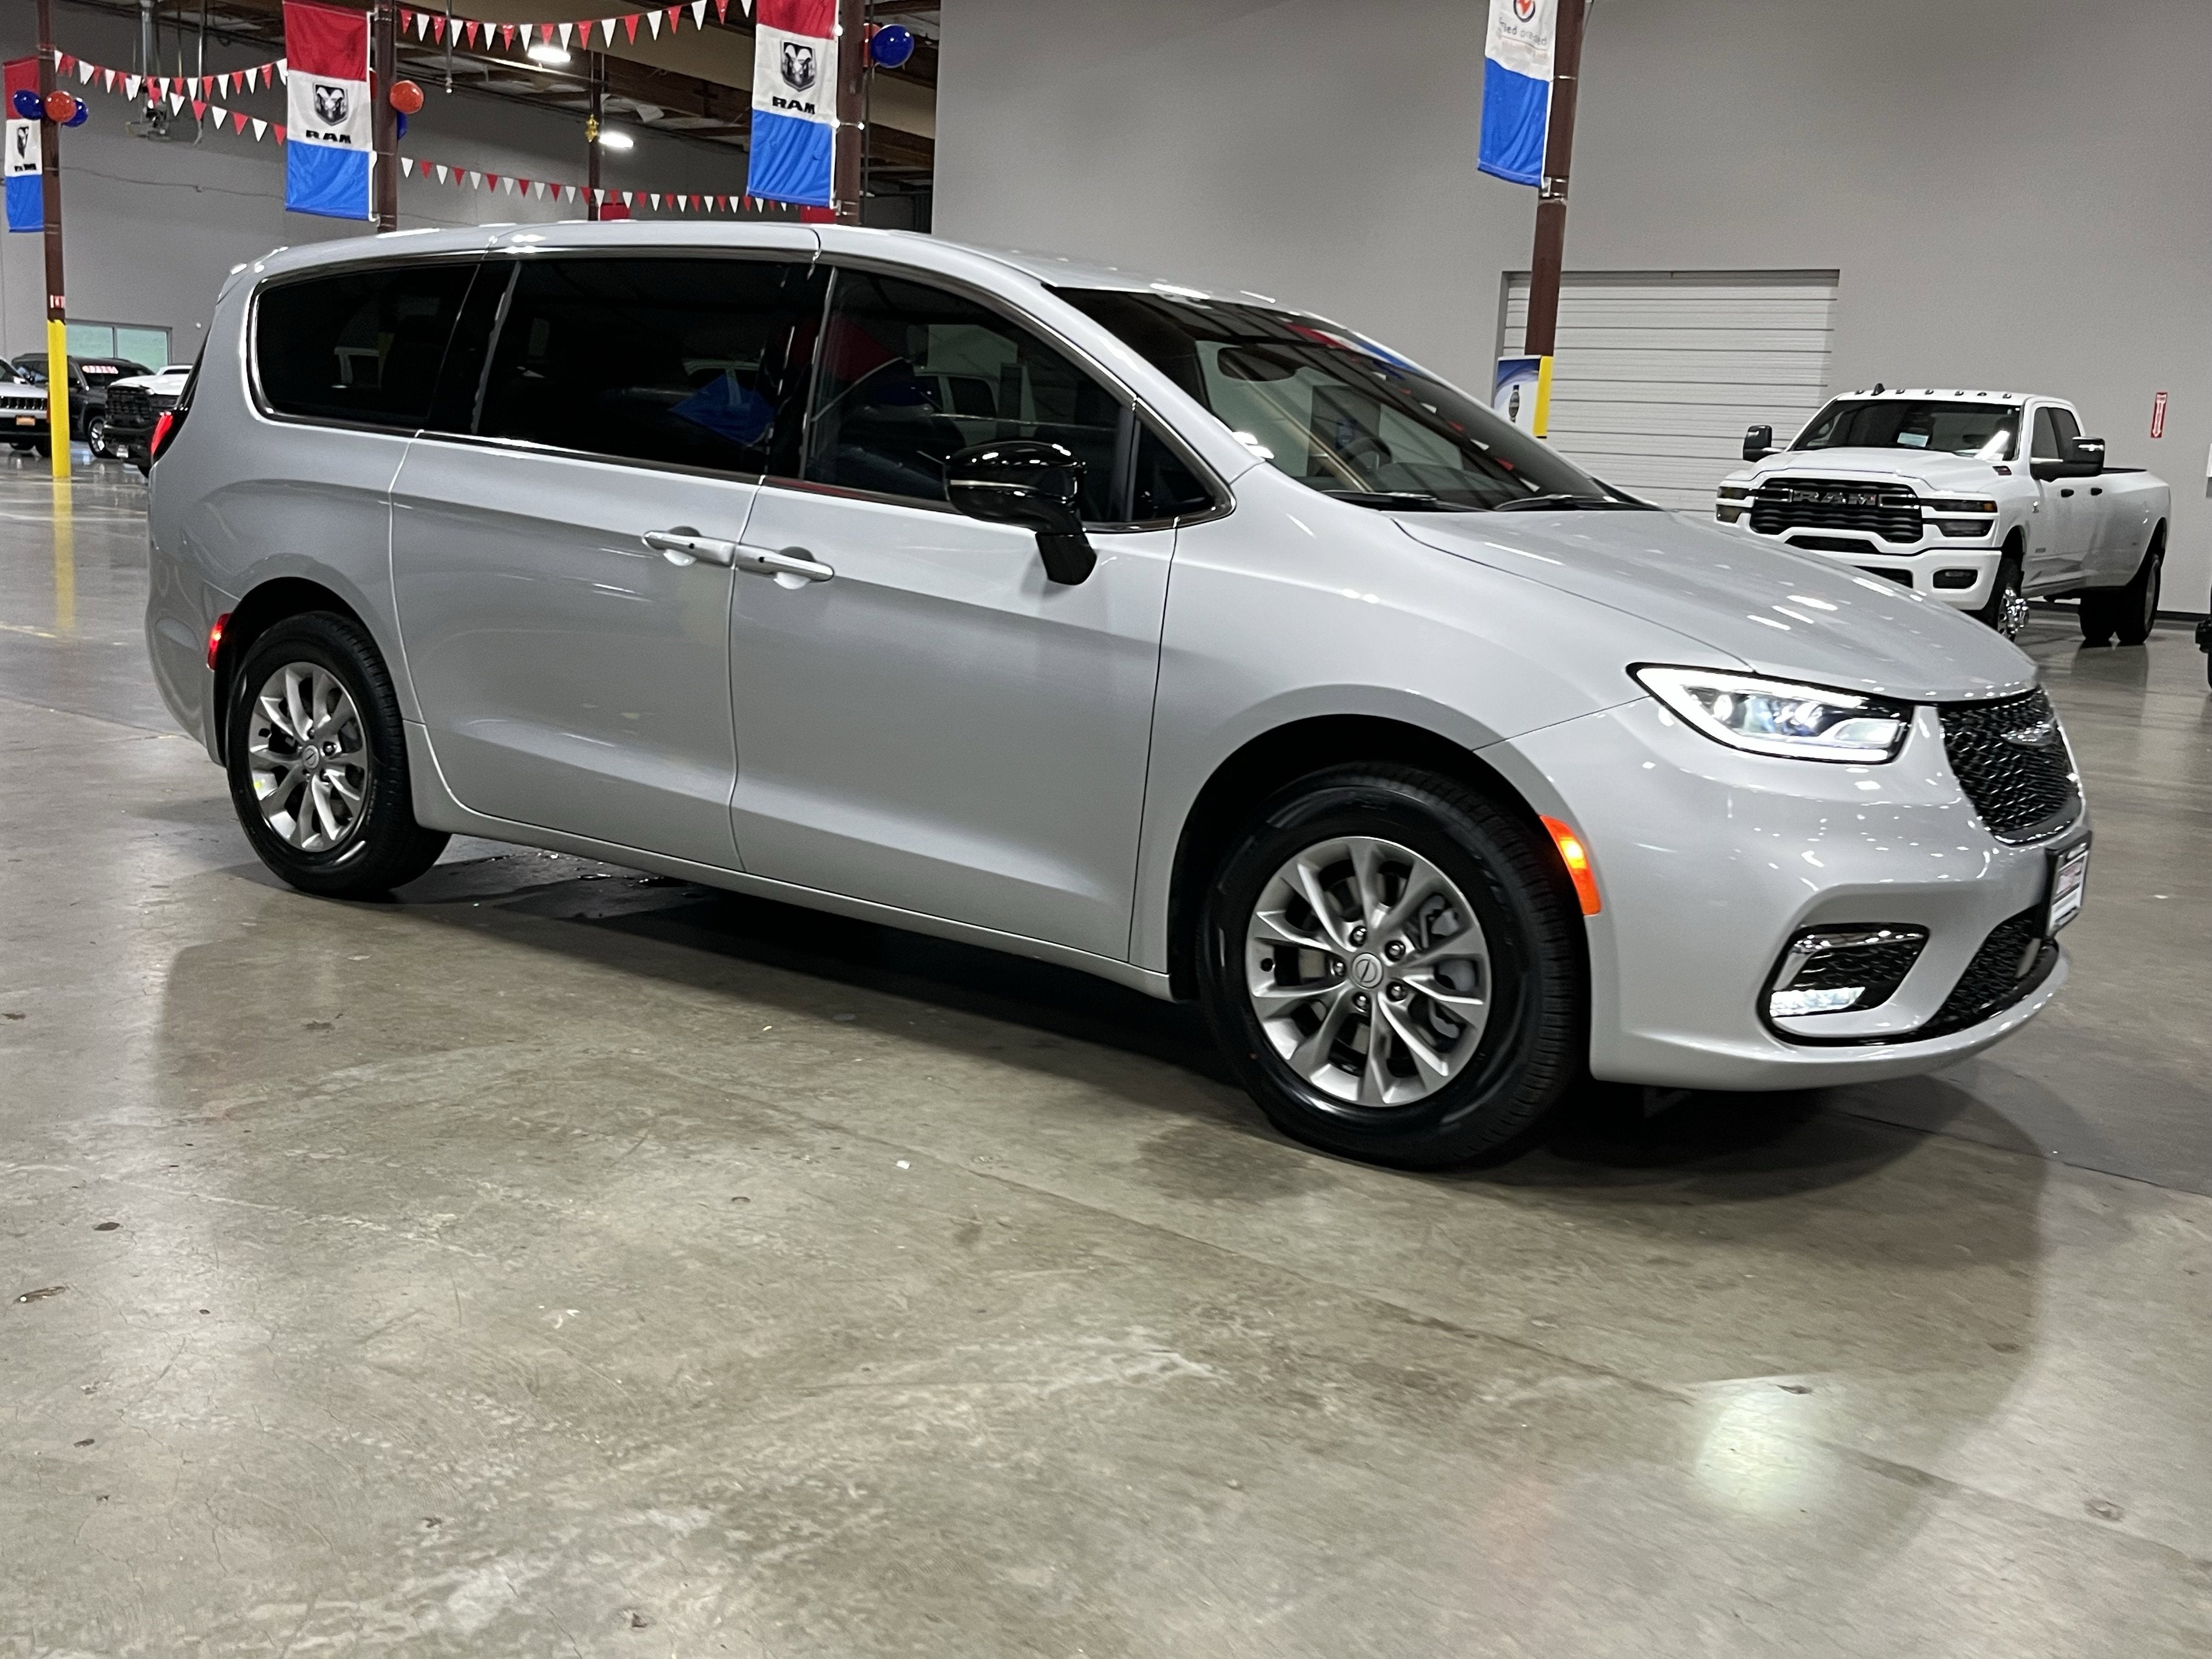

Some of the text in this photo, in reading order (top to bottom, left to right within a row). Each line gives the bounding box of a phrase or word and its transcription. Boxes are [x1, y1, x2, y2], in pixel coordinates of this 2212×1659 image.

[772, 95, 816, 115] RAM
[306, 129, 352, 144] RAM
[1793, 489, 1877, 506] RAM
